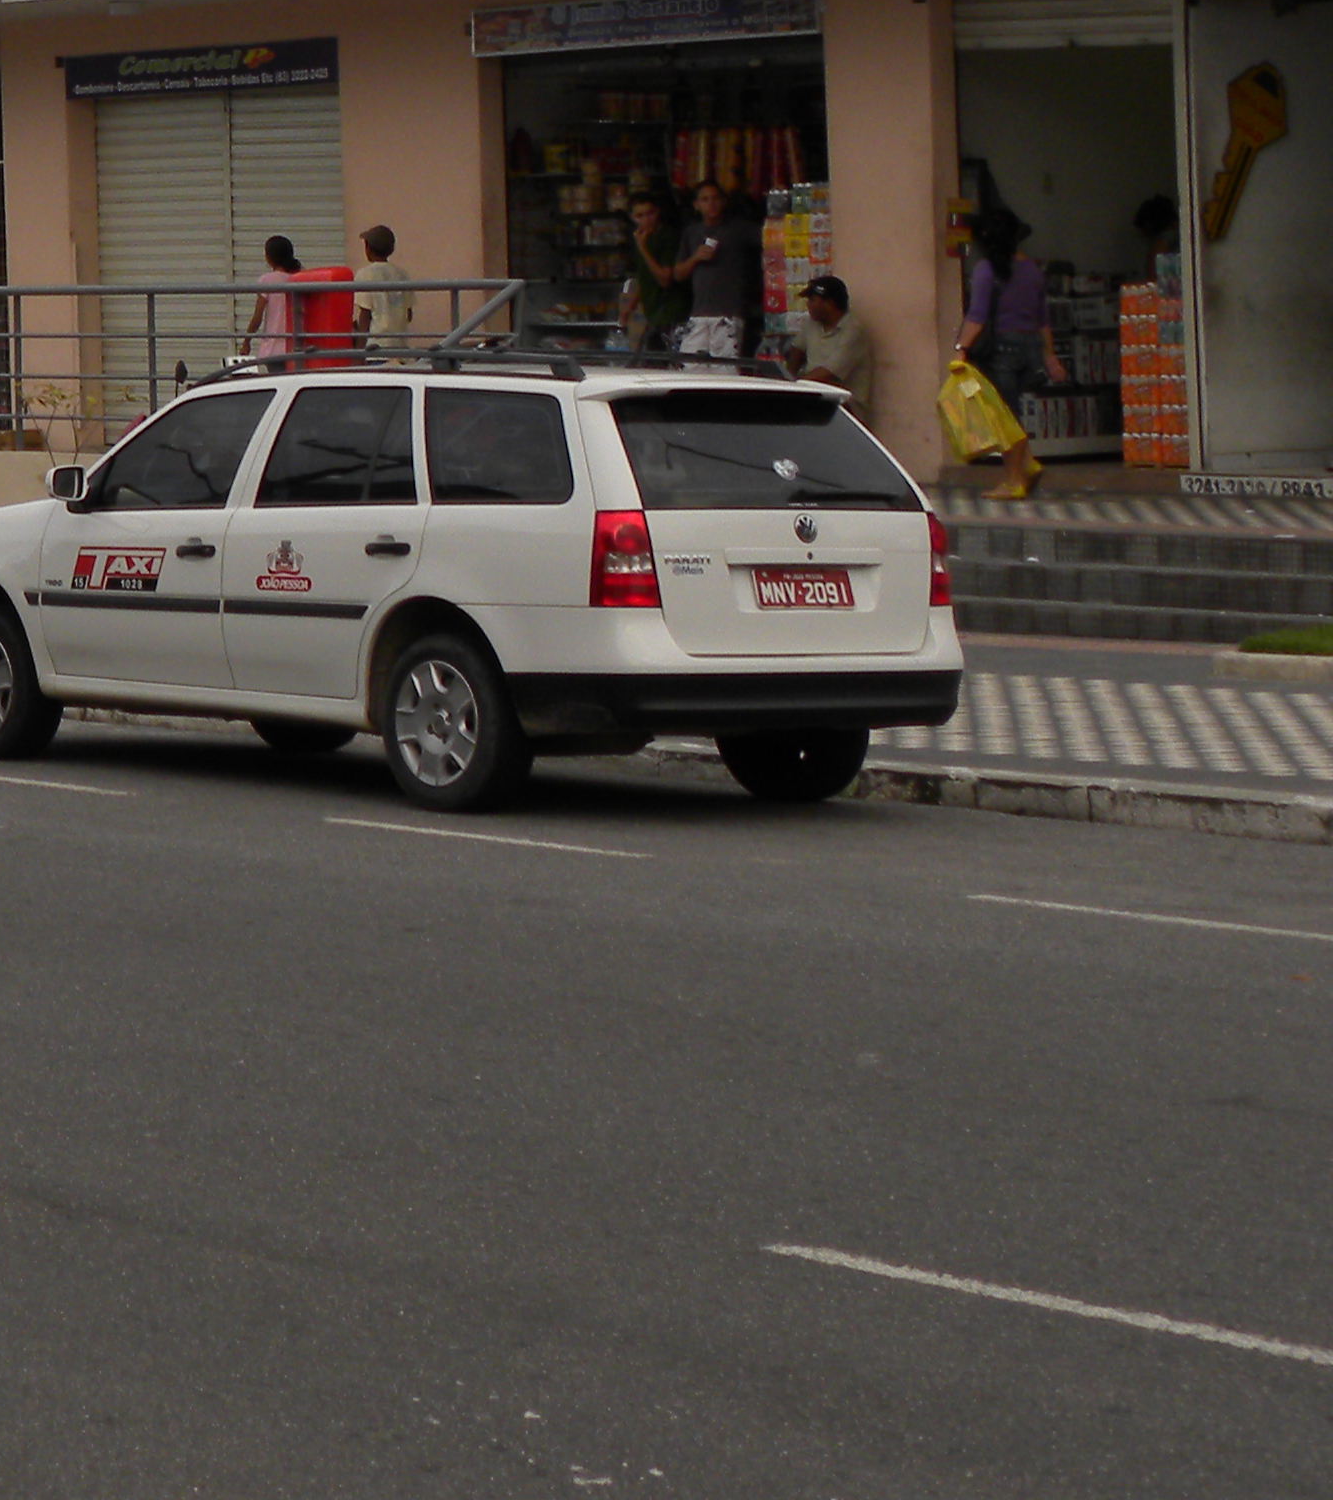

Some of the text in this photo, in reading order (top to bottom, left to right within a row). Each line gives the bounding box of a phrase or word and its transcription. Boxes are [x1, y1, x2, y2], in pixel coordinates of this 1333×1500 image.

[119, 50, 241, 76] Comercial
[79, 550, 164, 588] TAXI
[664, 554, 711, 566] PARATI
